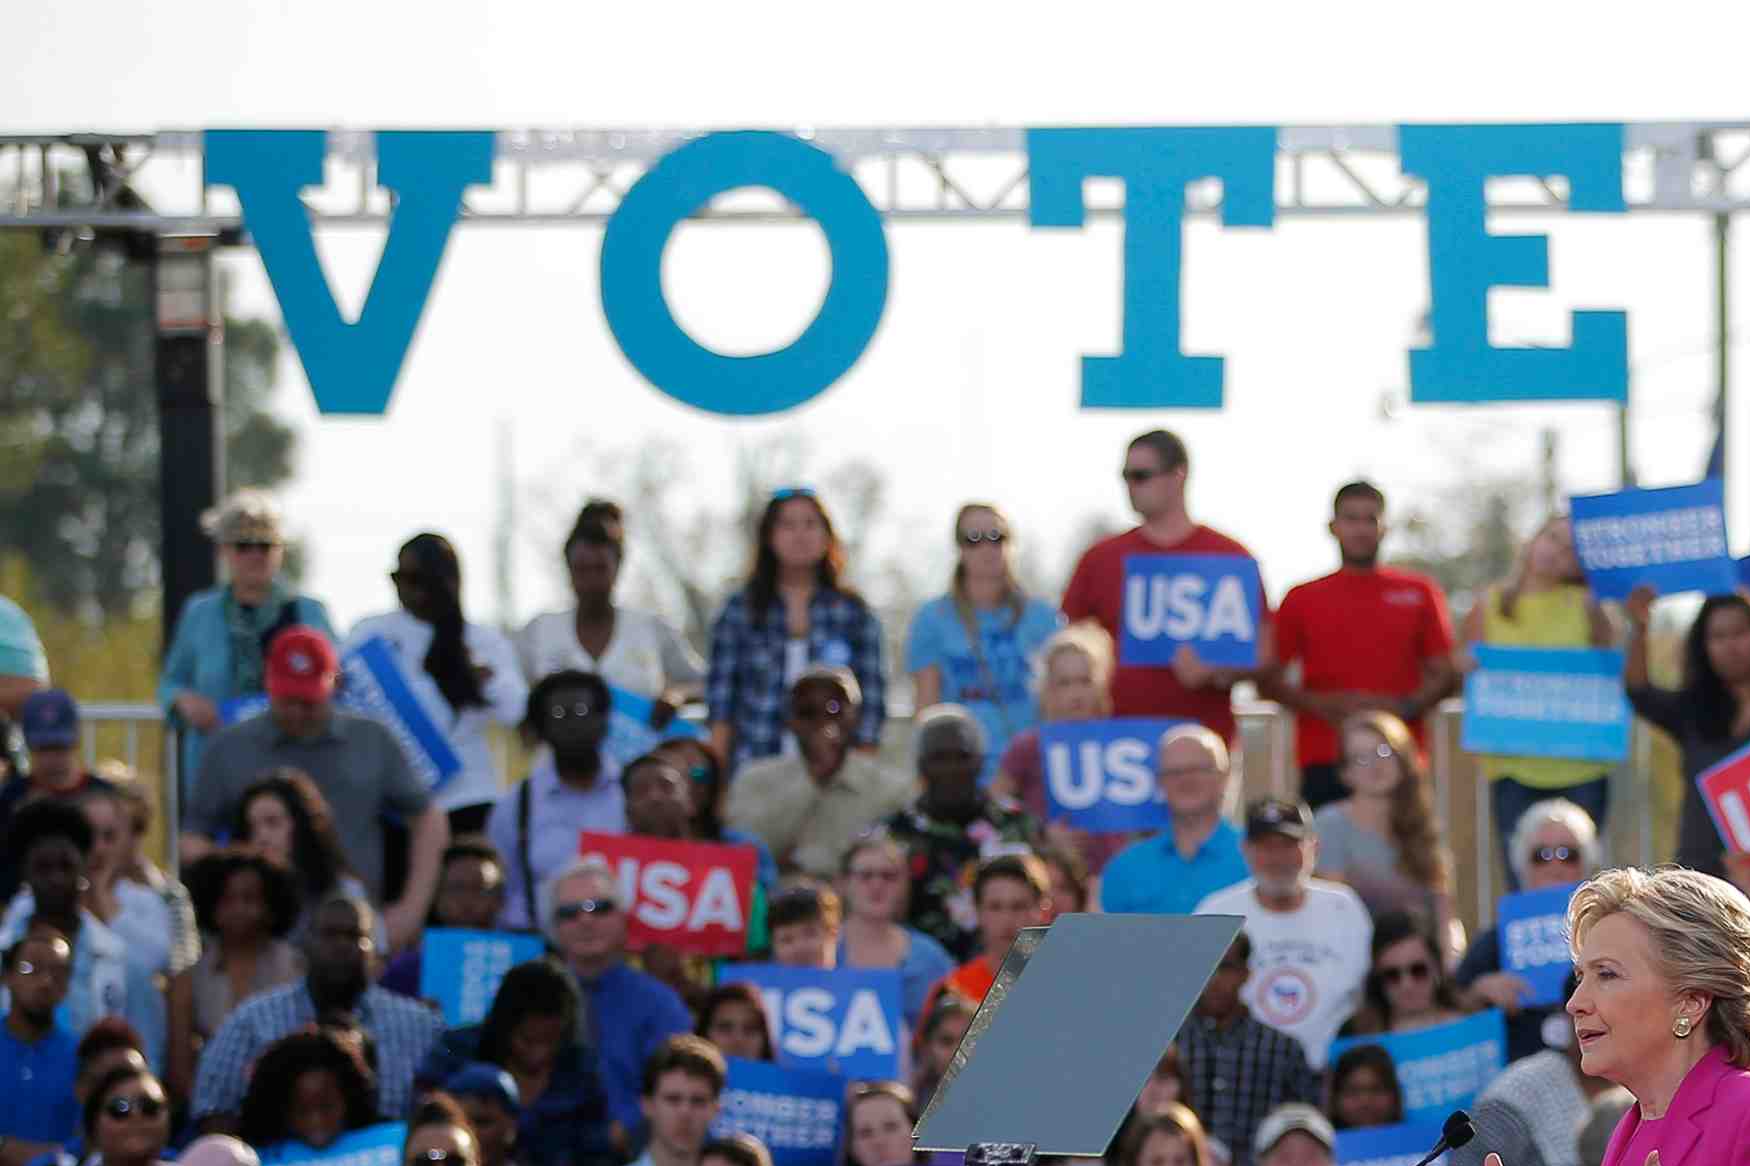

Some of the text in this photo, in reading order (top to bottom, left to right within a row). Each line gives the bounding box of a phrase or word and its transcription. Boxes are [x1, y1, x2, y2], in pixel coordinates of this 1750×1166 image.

[204, 124, 1629, 417] VOTE
[1126, 573, 1254, 641] USA
[1045, 737, 1168, 811] US
